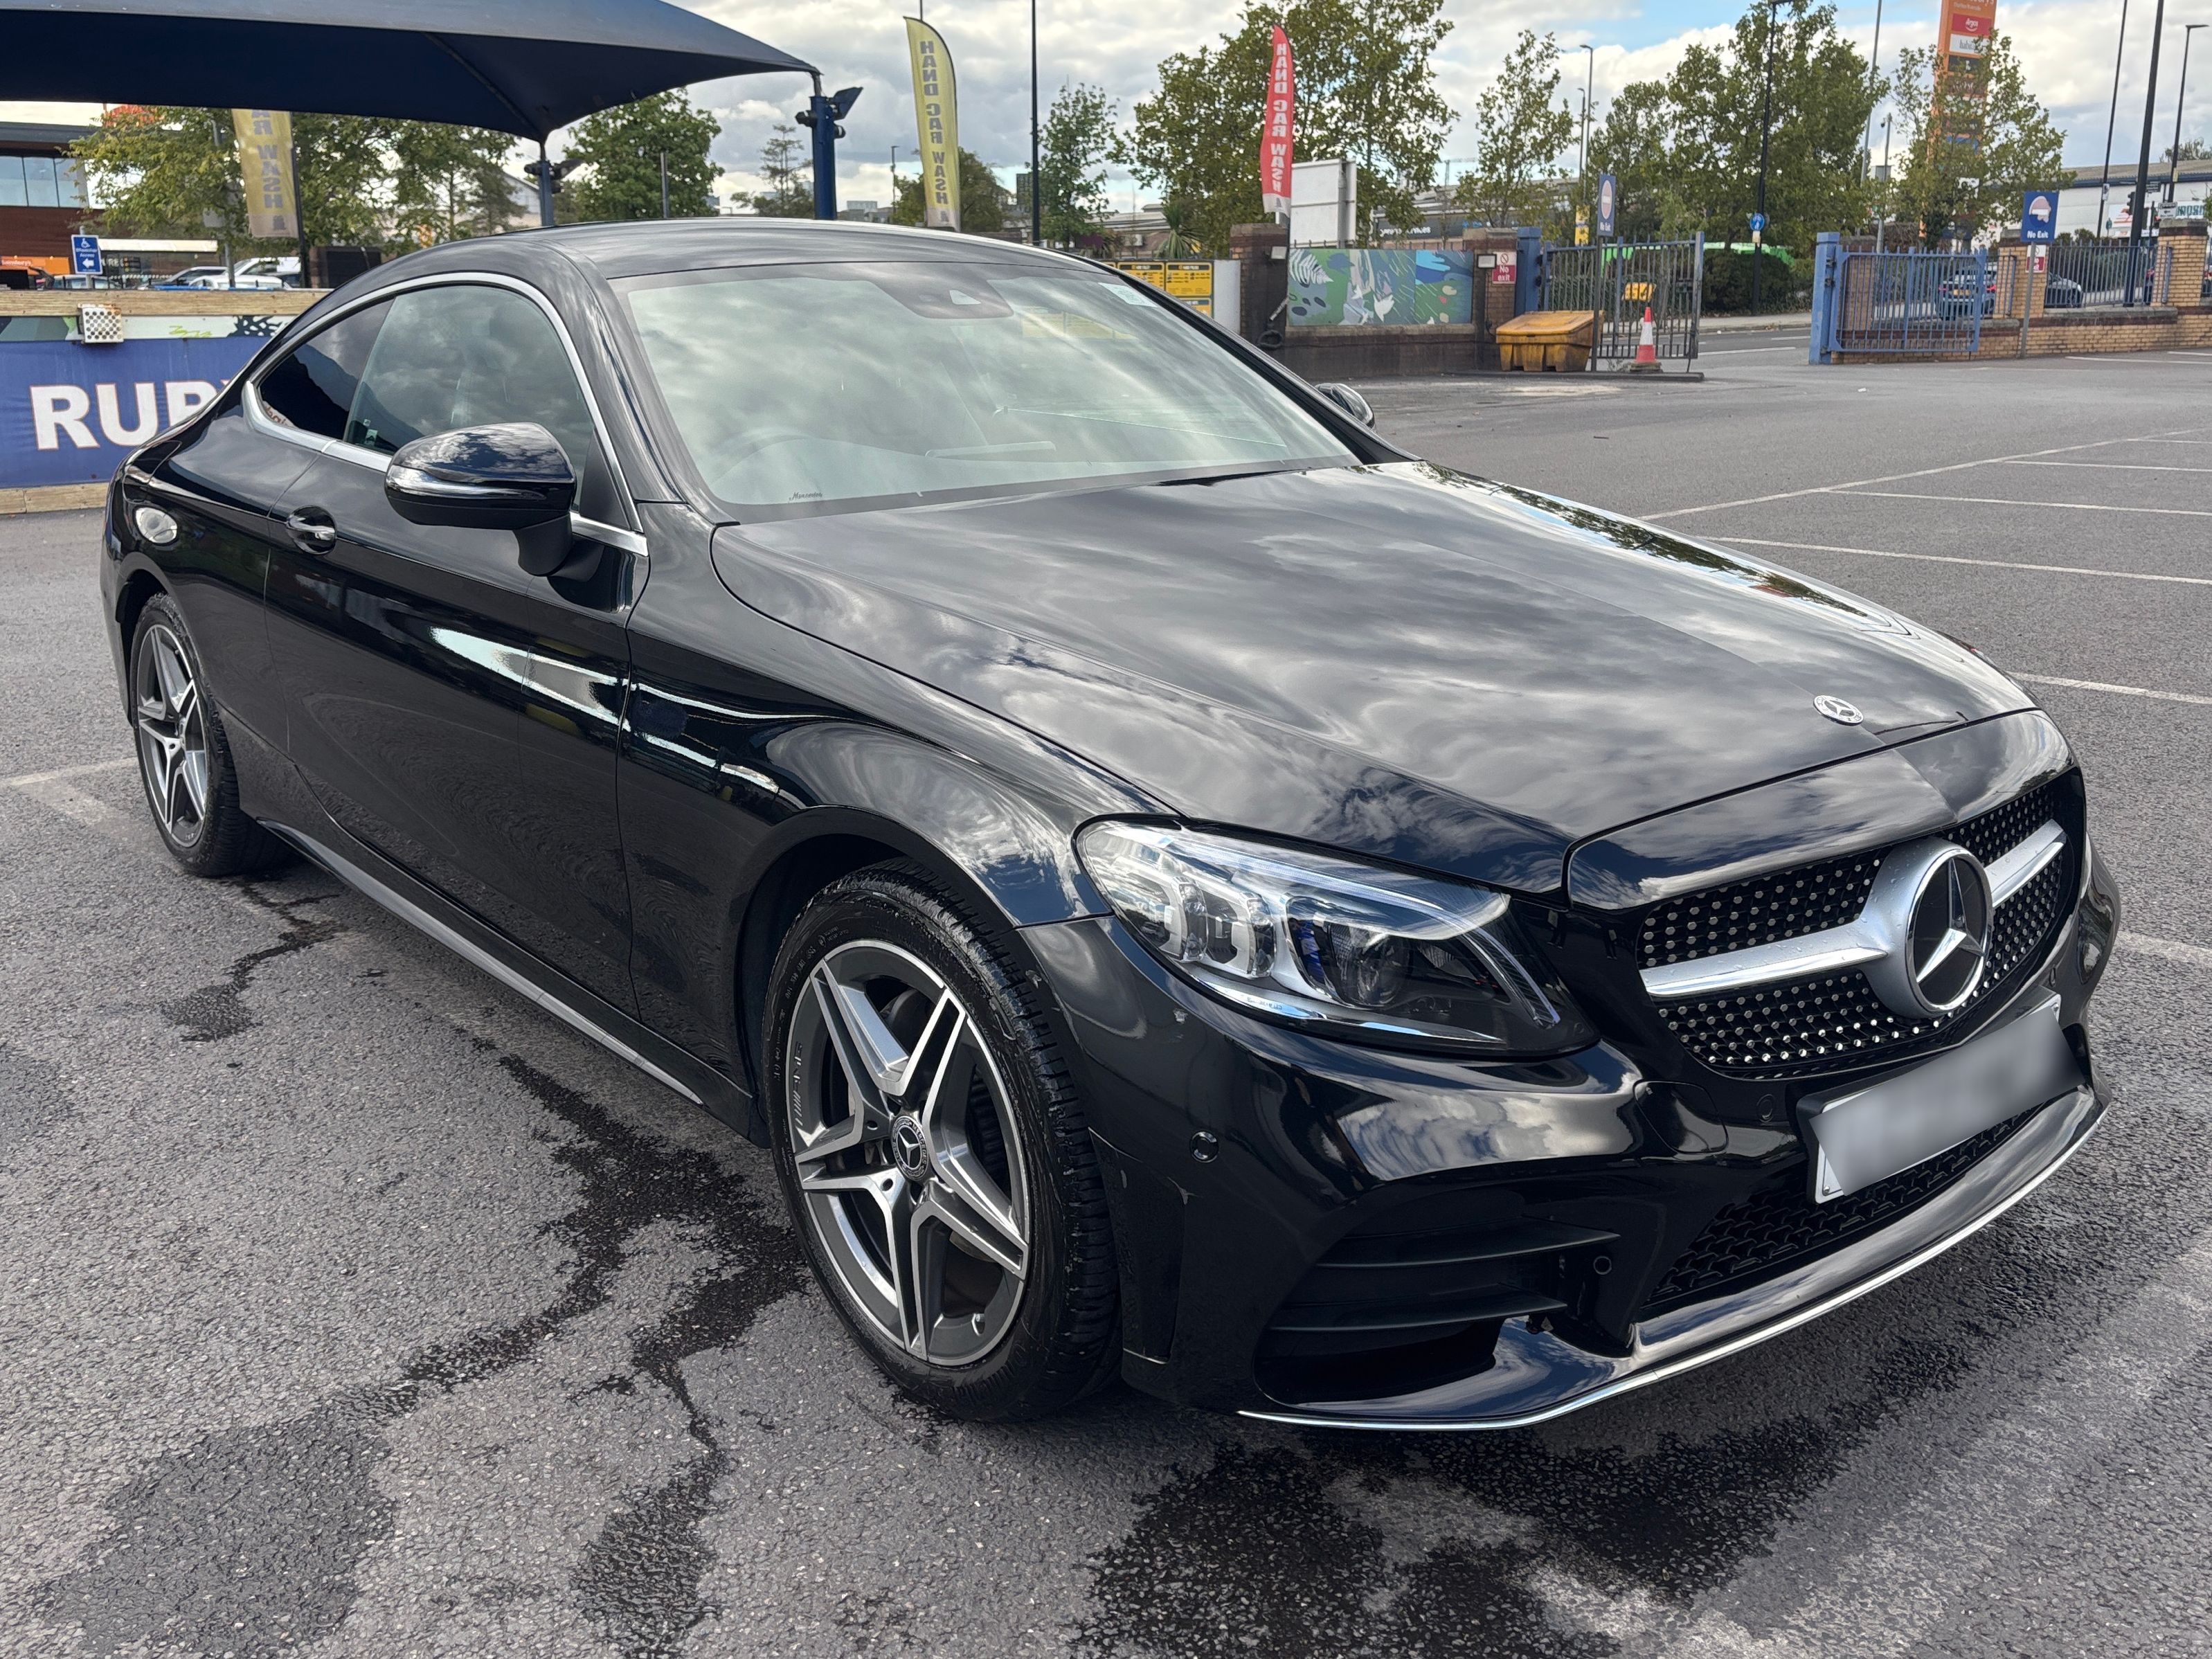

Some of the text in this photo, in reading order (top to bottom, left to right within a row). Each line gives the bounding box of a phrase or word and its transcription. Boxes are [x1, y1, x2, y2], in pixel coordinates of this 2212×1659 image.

[2027, 230, 2049, 239] No Exit
[1500, 264, 1509, 273] No
[1498, 273, 1510, 281] exit
[30, 379, 231, 450] RU
[912, 1122, 927, 1164] MERCEDES
